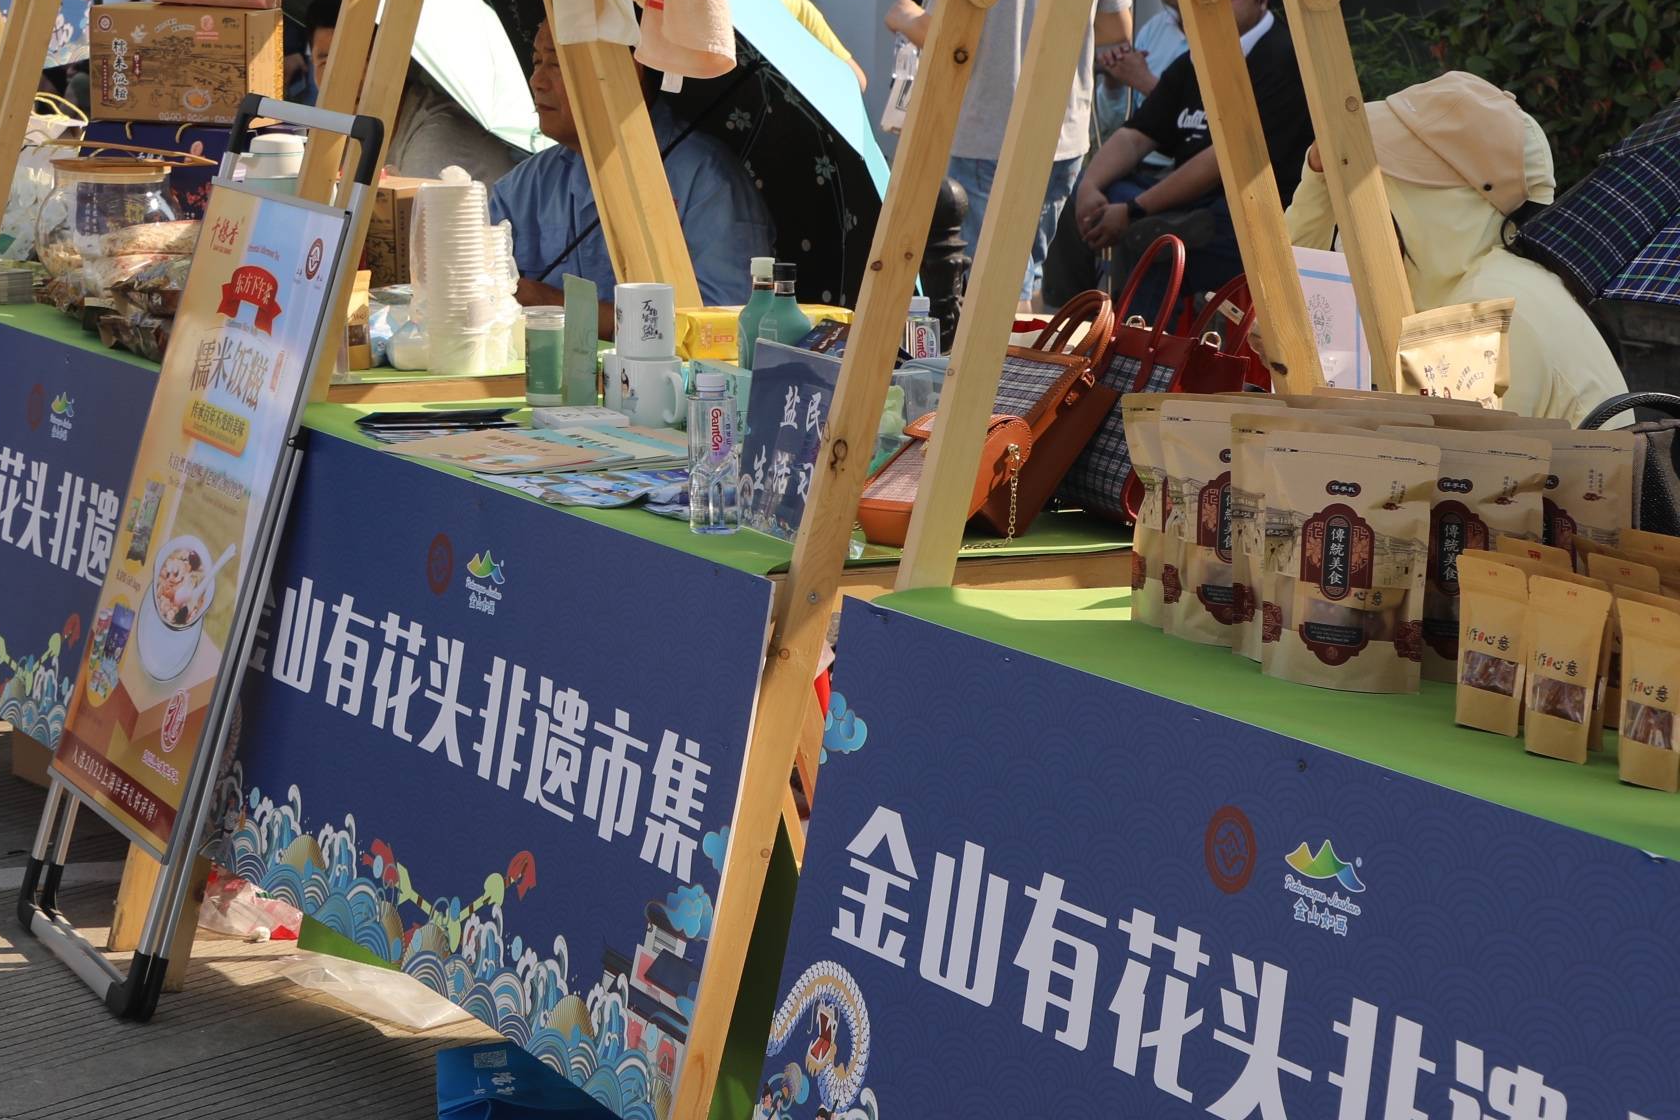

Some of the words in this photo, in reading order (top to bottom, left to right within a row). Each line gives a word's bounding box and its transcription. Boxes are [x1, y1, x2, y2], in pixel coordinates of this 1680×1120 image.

[1327, 527, 1346, 586] 傳統美食
[1293, 897, 1347, 937] 金山如画
